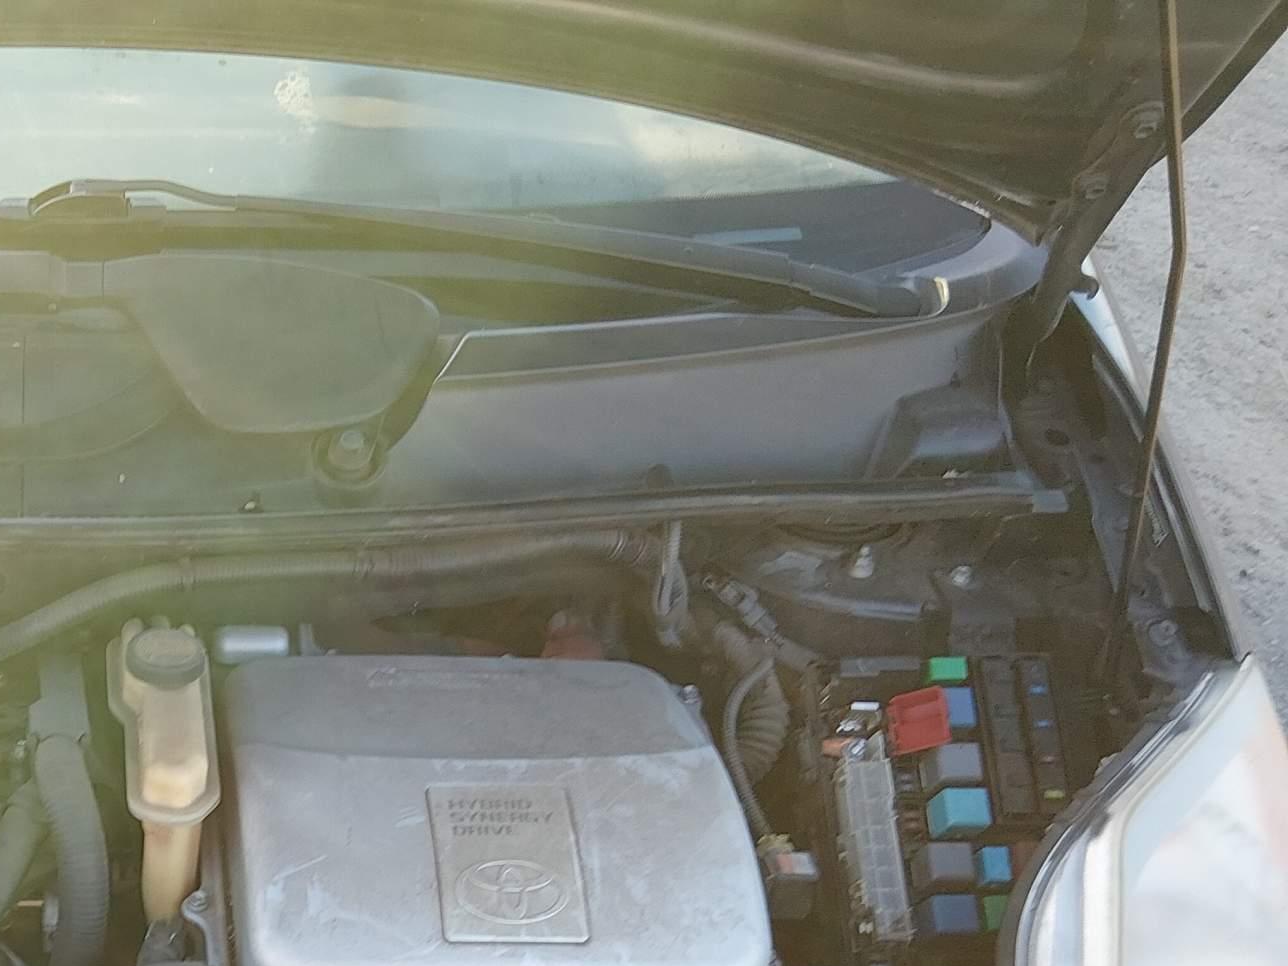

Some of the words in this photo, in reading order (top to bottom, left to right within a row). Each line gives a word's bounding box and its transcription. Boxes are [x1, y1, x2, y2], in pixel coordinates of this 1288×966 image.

[447, 799, 533, 810] HYBRID
[450, 811, 553, 823] SYNERGY
[453, 825, 514, 836] DRIVE
